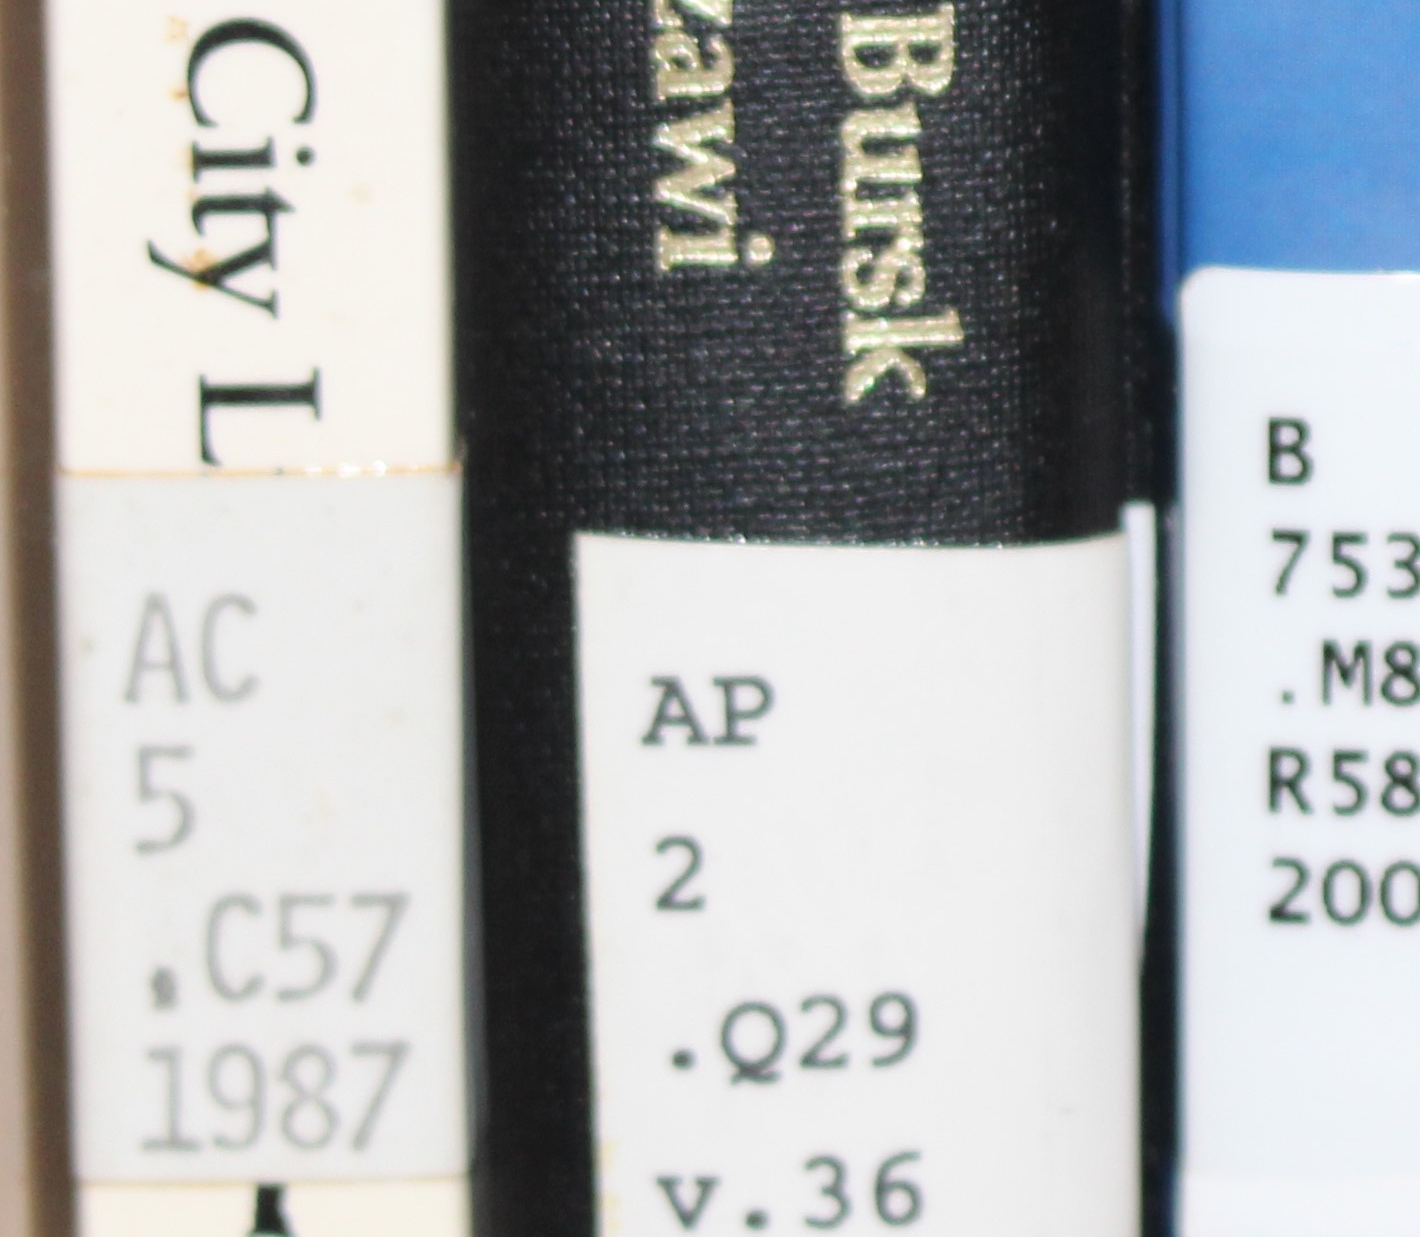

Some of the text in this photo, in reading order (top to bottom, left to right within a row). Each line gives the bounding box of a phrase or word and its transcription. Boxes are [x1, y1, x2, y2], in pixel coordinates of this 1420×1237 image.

[145, 17, 318, 319] City
[836, 1, 965, 405] Bursk
[1264, 414, 1316, 488] B
[124, 594, 255, 703] AC
[639, 674, 776, 749] AP
[136, 746, 194, 854] 5
[653, 833, 707, 914] 2
[149, 893, 407, 1011] .C57
[669, 990, 920, 1087] .Q29
[143, 1041, 408, 1152] 1987
[654, 1149, 925, 1233] v.36
